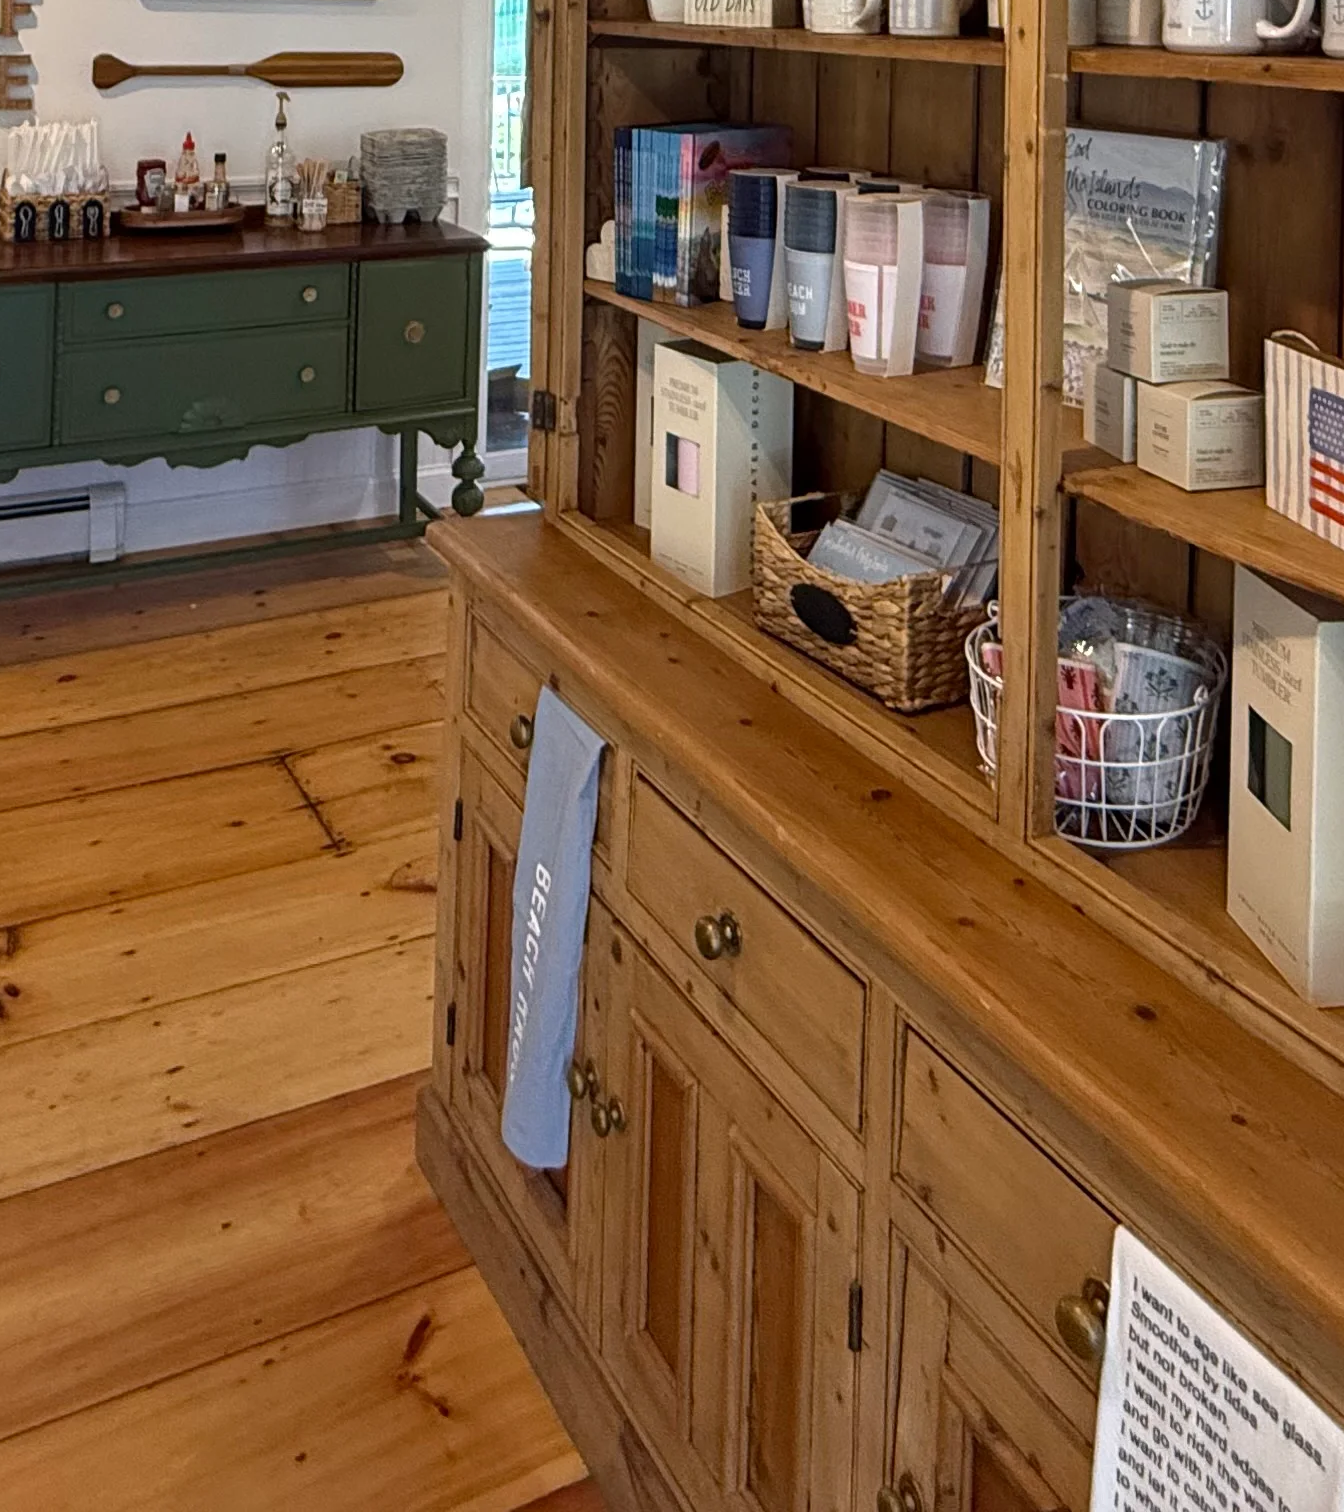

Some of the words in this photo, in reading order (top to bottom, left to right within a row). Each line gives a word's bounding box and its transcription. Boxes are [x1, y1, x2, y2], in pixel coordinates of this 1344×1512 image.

[1086, 198, 1149, 218] COLORING
[1150, 207, 1188, 224] BOOK
[520, 862, 552, 991] BEACH
[1129, 1325, 1150, 1358] but
[1154, 1347, 1176, 1379] not
[1130, 1301, 1199, 1372] Smoothed
[1202, 1369, 1220, 1395] by
[1223, 1385, 1259, 1430] tides
[1133, 1276, 1138, 1292] I
[1141, 1285, 1174, 1323] want
[1177, 1313, 1190, 1339] to
[1194, 1336, 1219, 1367] age
[1222, 1358, 1248, 1393] like
[1252, 1389, 1279, 1423] sea
[1282, 1420, 1327, 1472] glass.
[1120, 1420, 1125, 1436] I
[1130, 1430, 1163, 1469] want
[1167, 1463, 1181, 1486] to
[1123, 1399, 1149, 1429] and
[1152, 1427, 1170, 1449] go
[1173, 1447, 1202, 1480] with
[1206, 1475, 1228, 1508] the
[1125, 1371, 1130, 1387] I
[1134, 1382, 1167, 1420] want
[1169, 1414, 1183, 1436] to
[1186, 1433, 1215, 1467] ride
[1217, 1462, 1241, 1496] the
[1127, 1348, 1132, 1364] I
[1135, 1358, 1168, 1397] want
[1171, 1391, 1192, 1418] my
[1195, 1411, 1228, 1454] hard
[1231, 1450, 1275, 1503] edges
[1114, 1492, 1119, 1508] I
[1116, 1468, 1130, 1491] to
[1118, 1448, 1145, 1478] and
[1148, 1474, 1167, 1501] let
